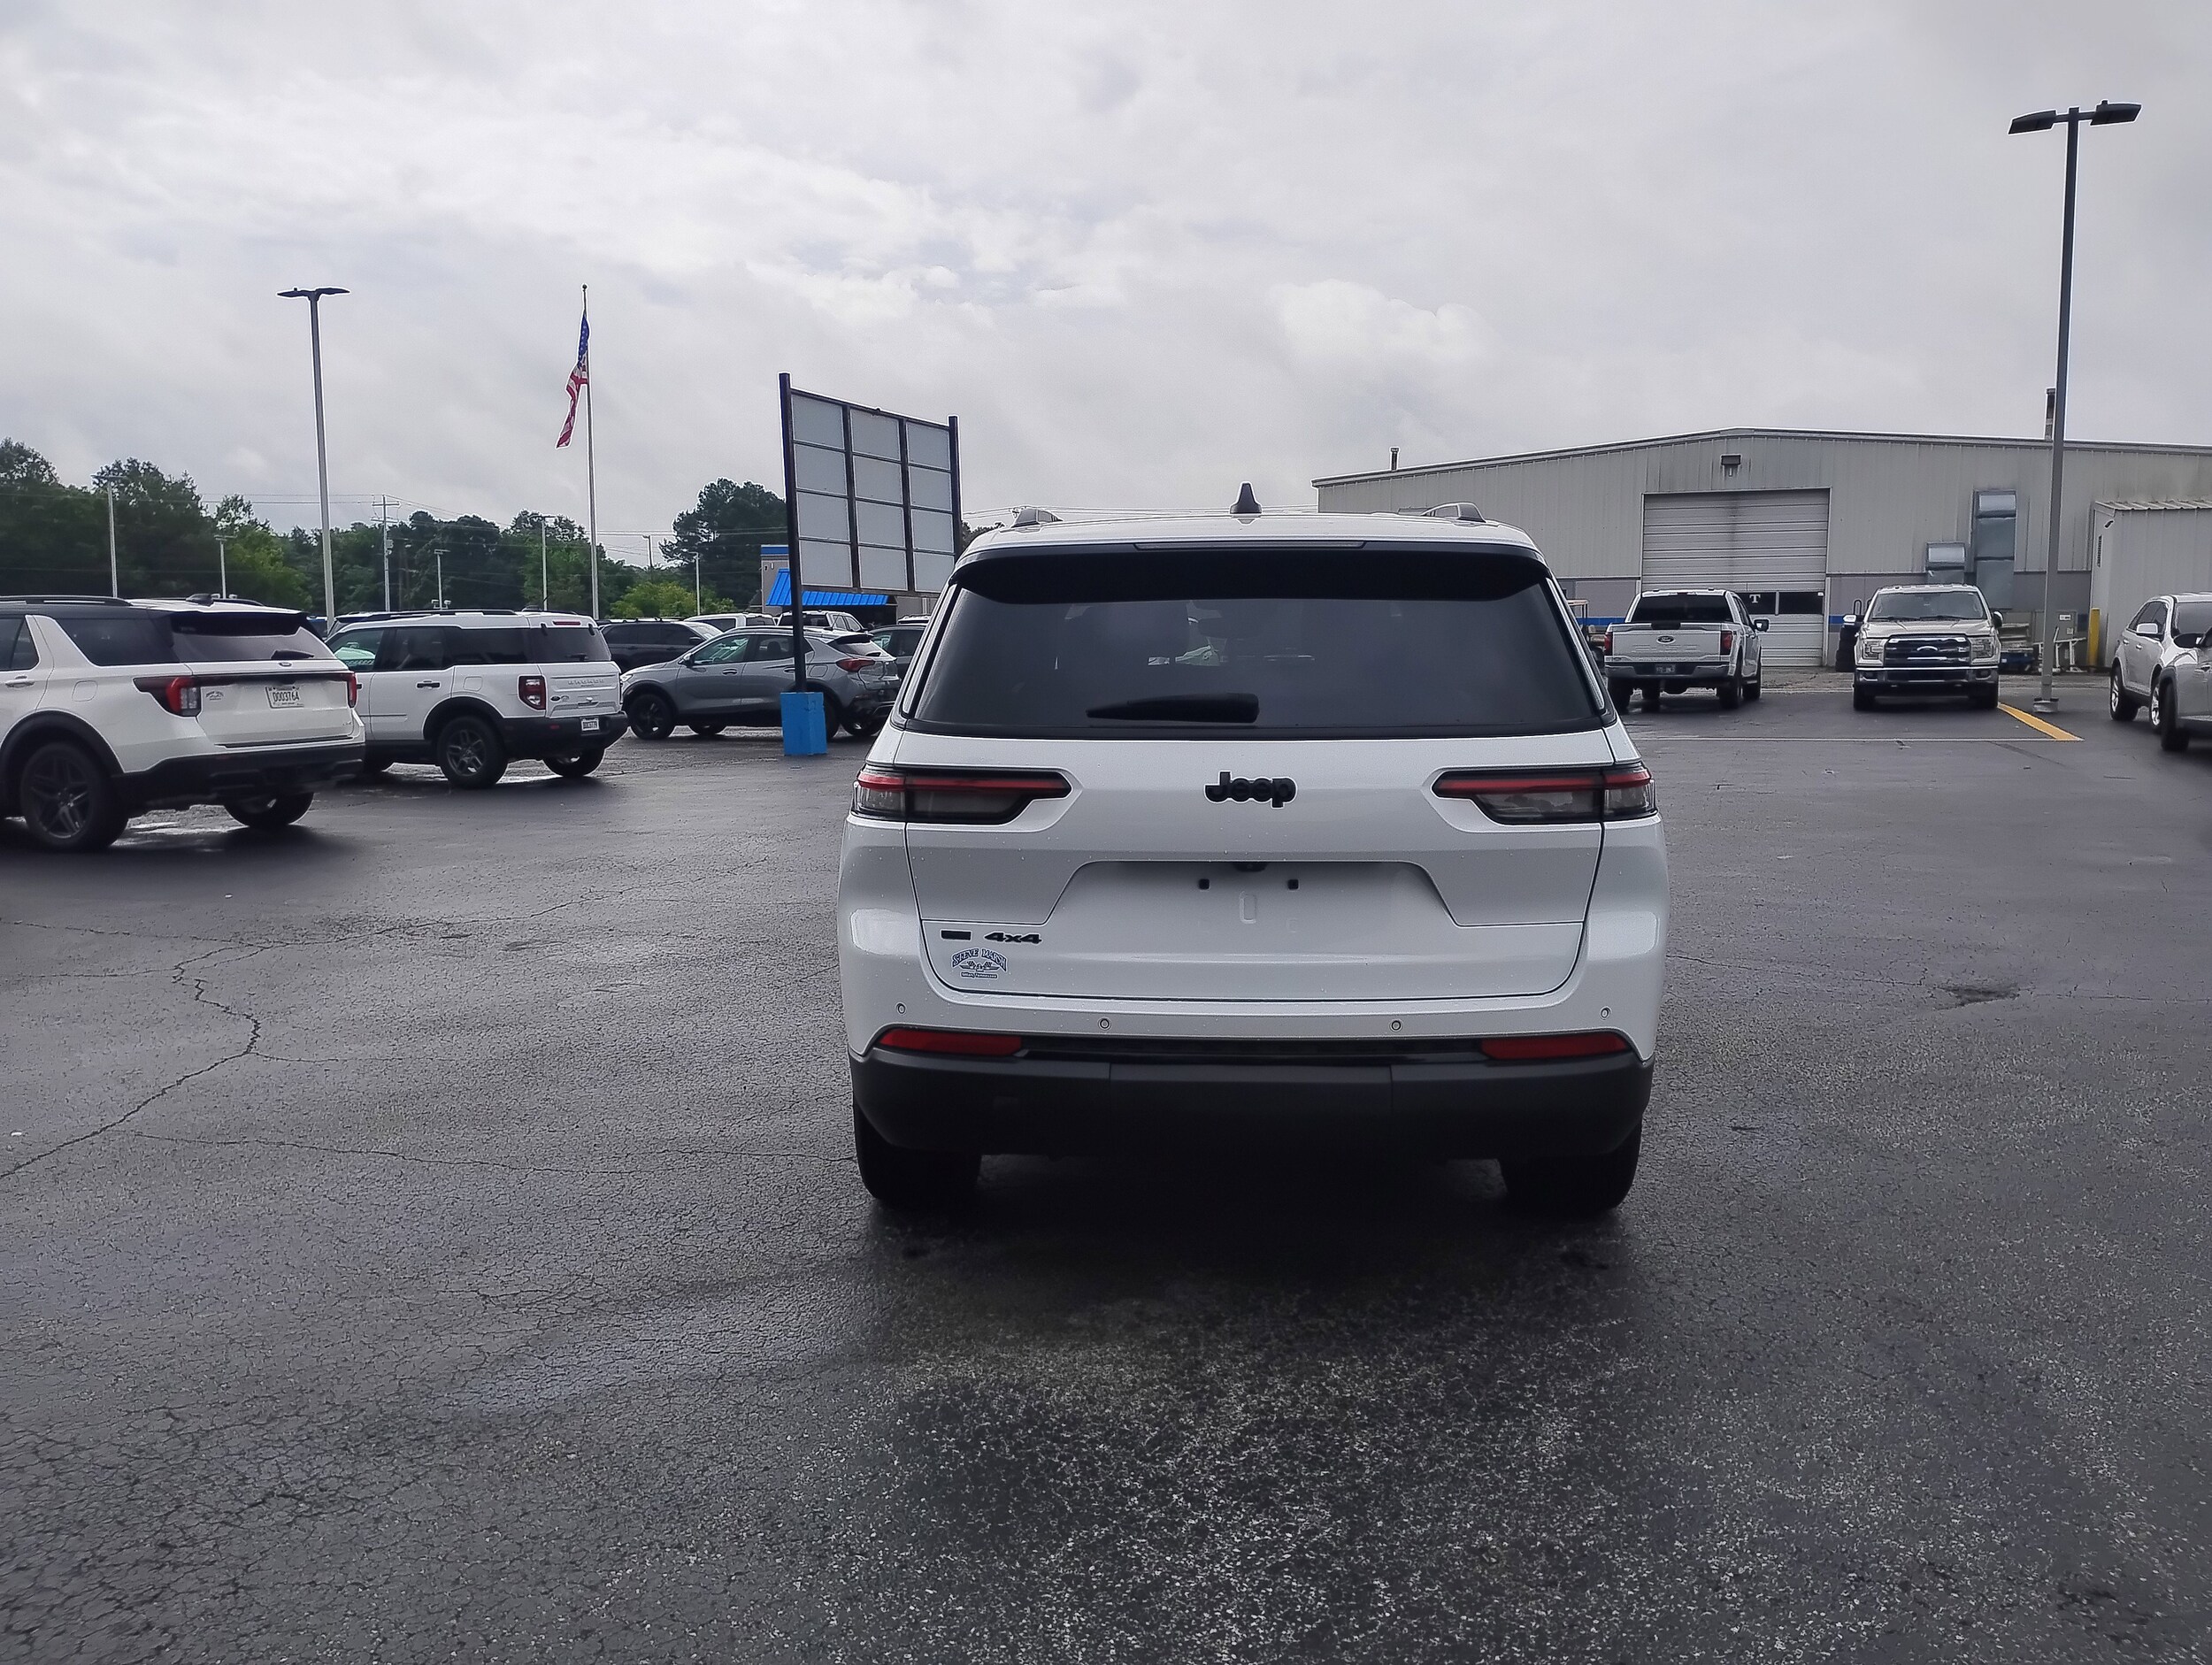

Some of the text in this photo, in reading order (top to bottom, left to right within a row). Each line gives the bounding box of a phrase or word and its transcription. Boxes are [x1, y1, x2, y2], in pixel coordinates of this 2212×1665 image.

[1204, 771, 1296, 809] Jeep
[984, 932, 1042, 944] 4x4
[952, 948, 1007, 972] STEVE MARSH
